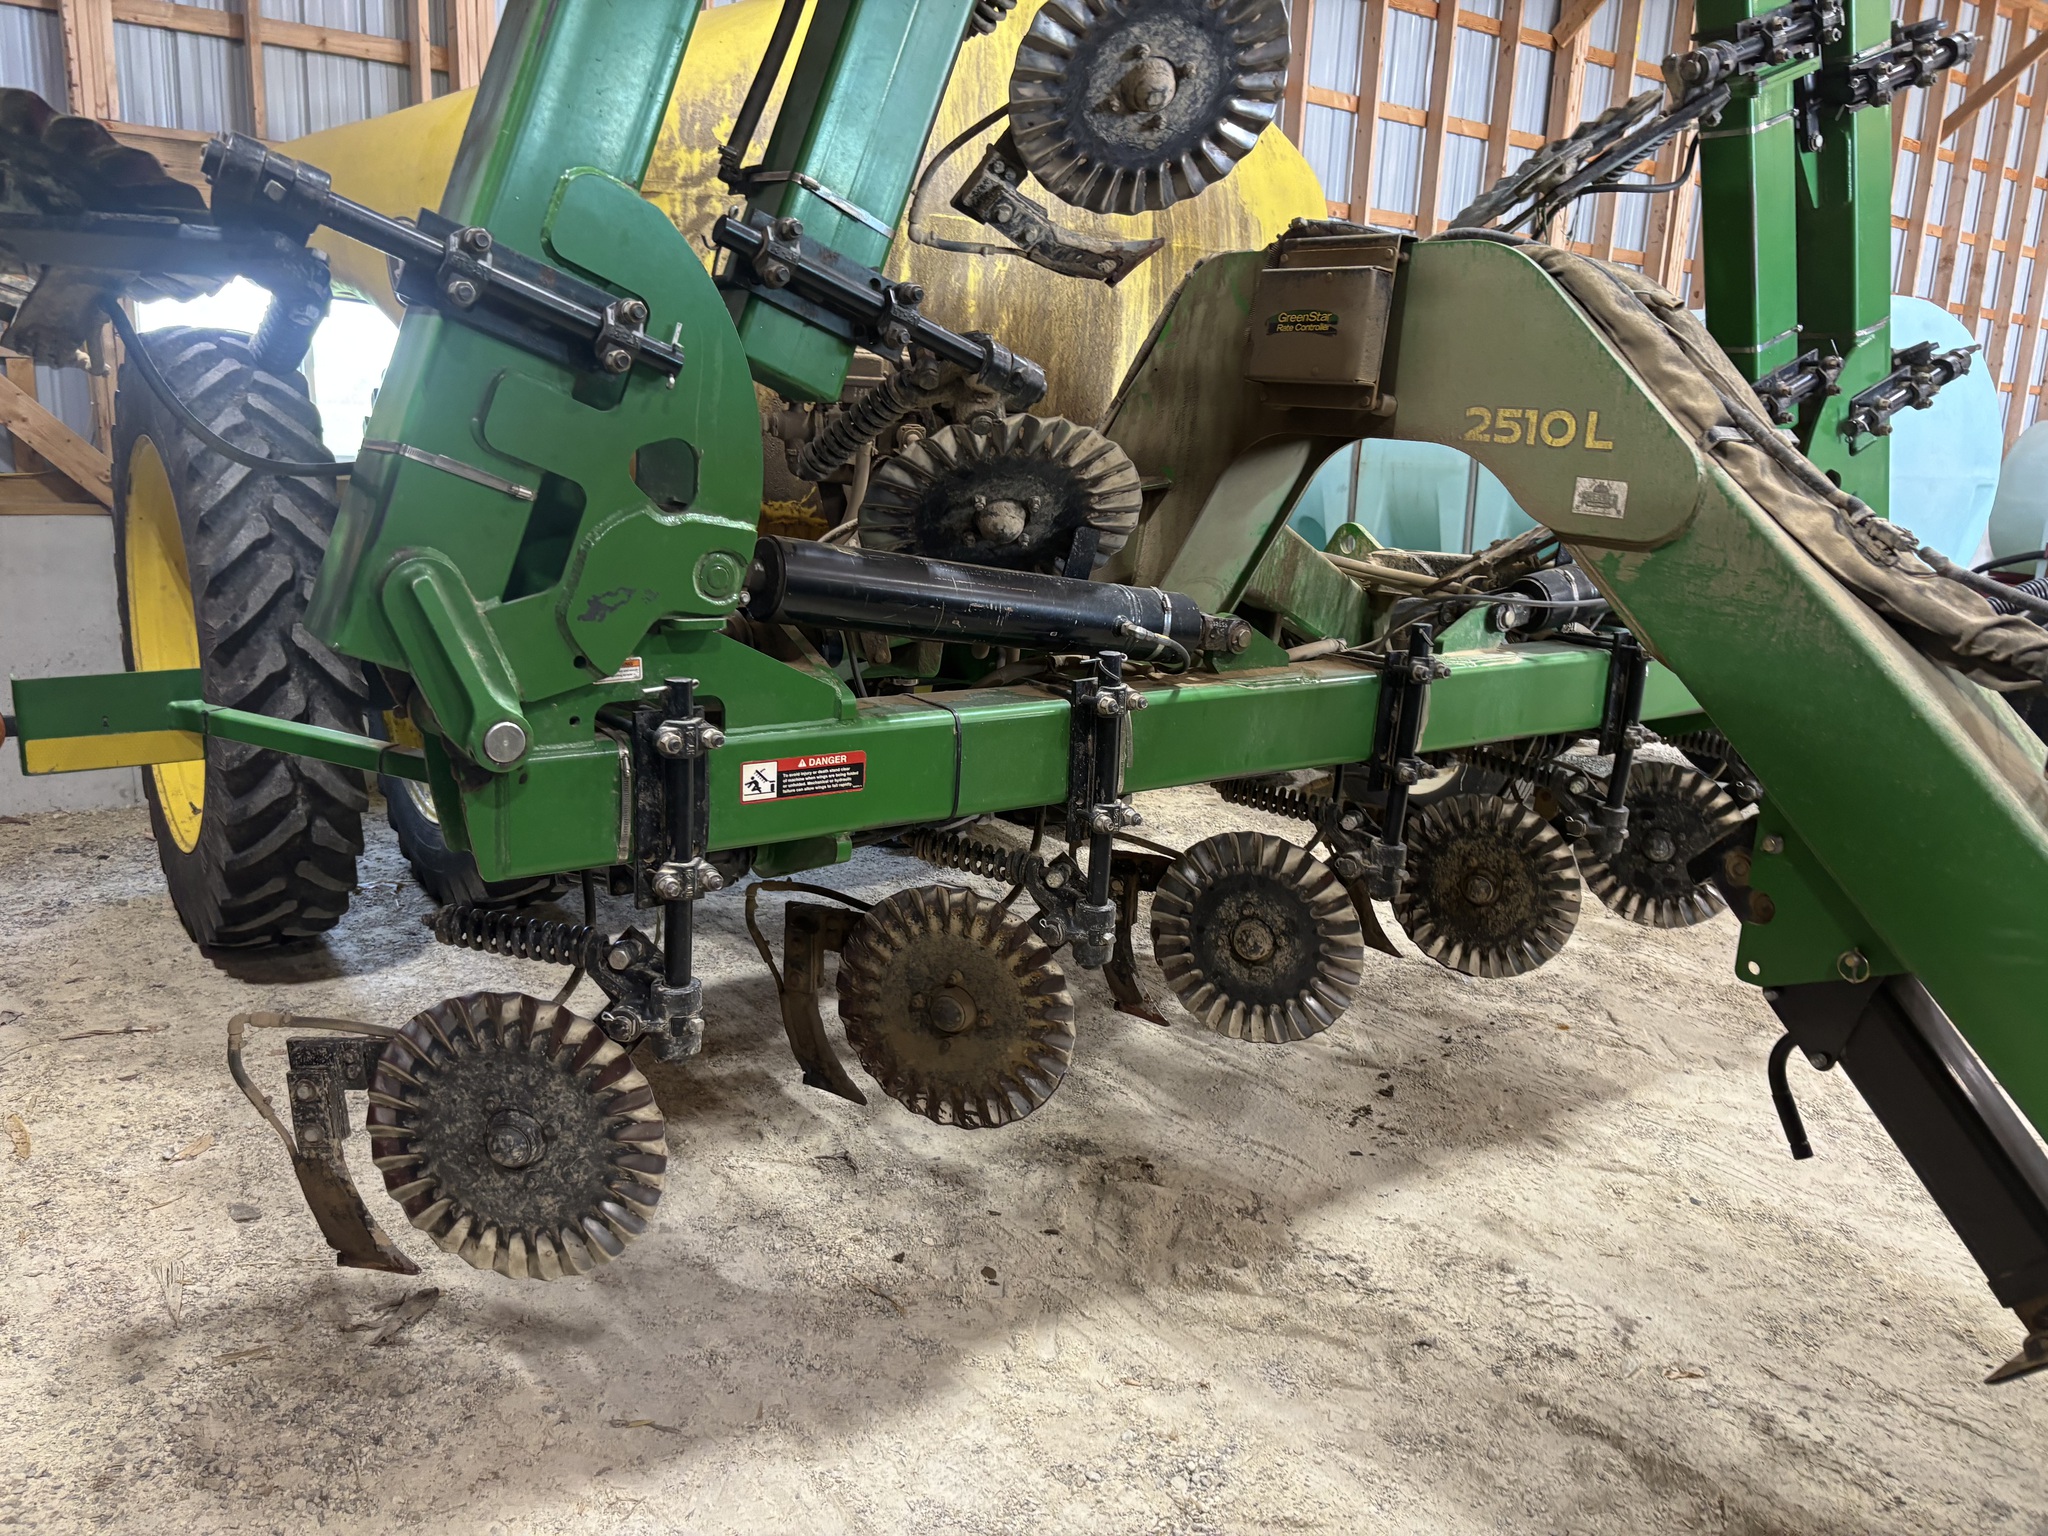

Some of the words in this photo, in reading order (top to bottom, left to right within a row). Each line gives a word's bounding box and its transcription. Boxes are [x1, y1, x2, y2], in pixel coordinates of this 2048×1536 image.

[1278, 312, 1332, 323] GreenStar
[1276, 324, 1294, 332] Rate
[1295, 323, 1329, 332] Controller
[808, 755, 847, 767] DANGER
